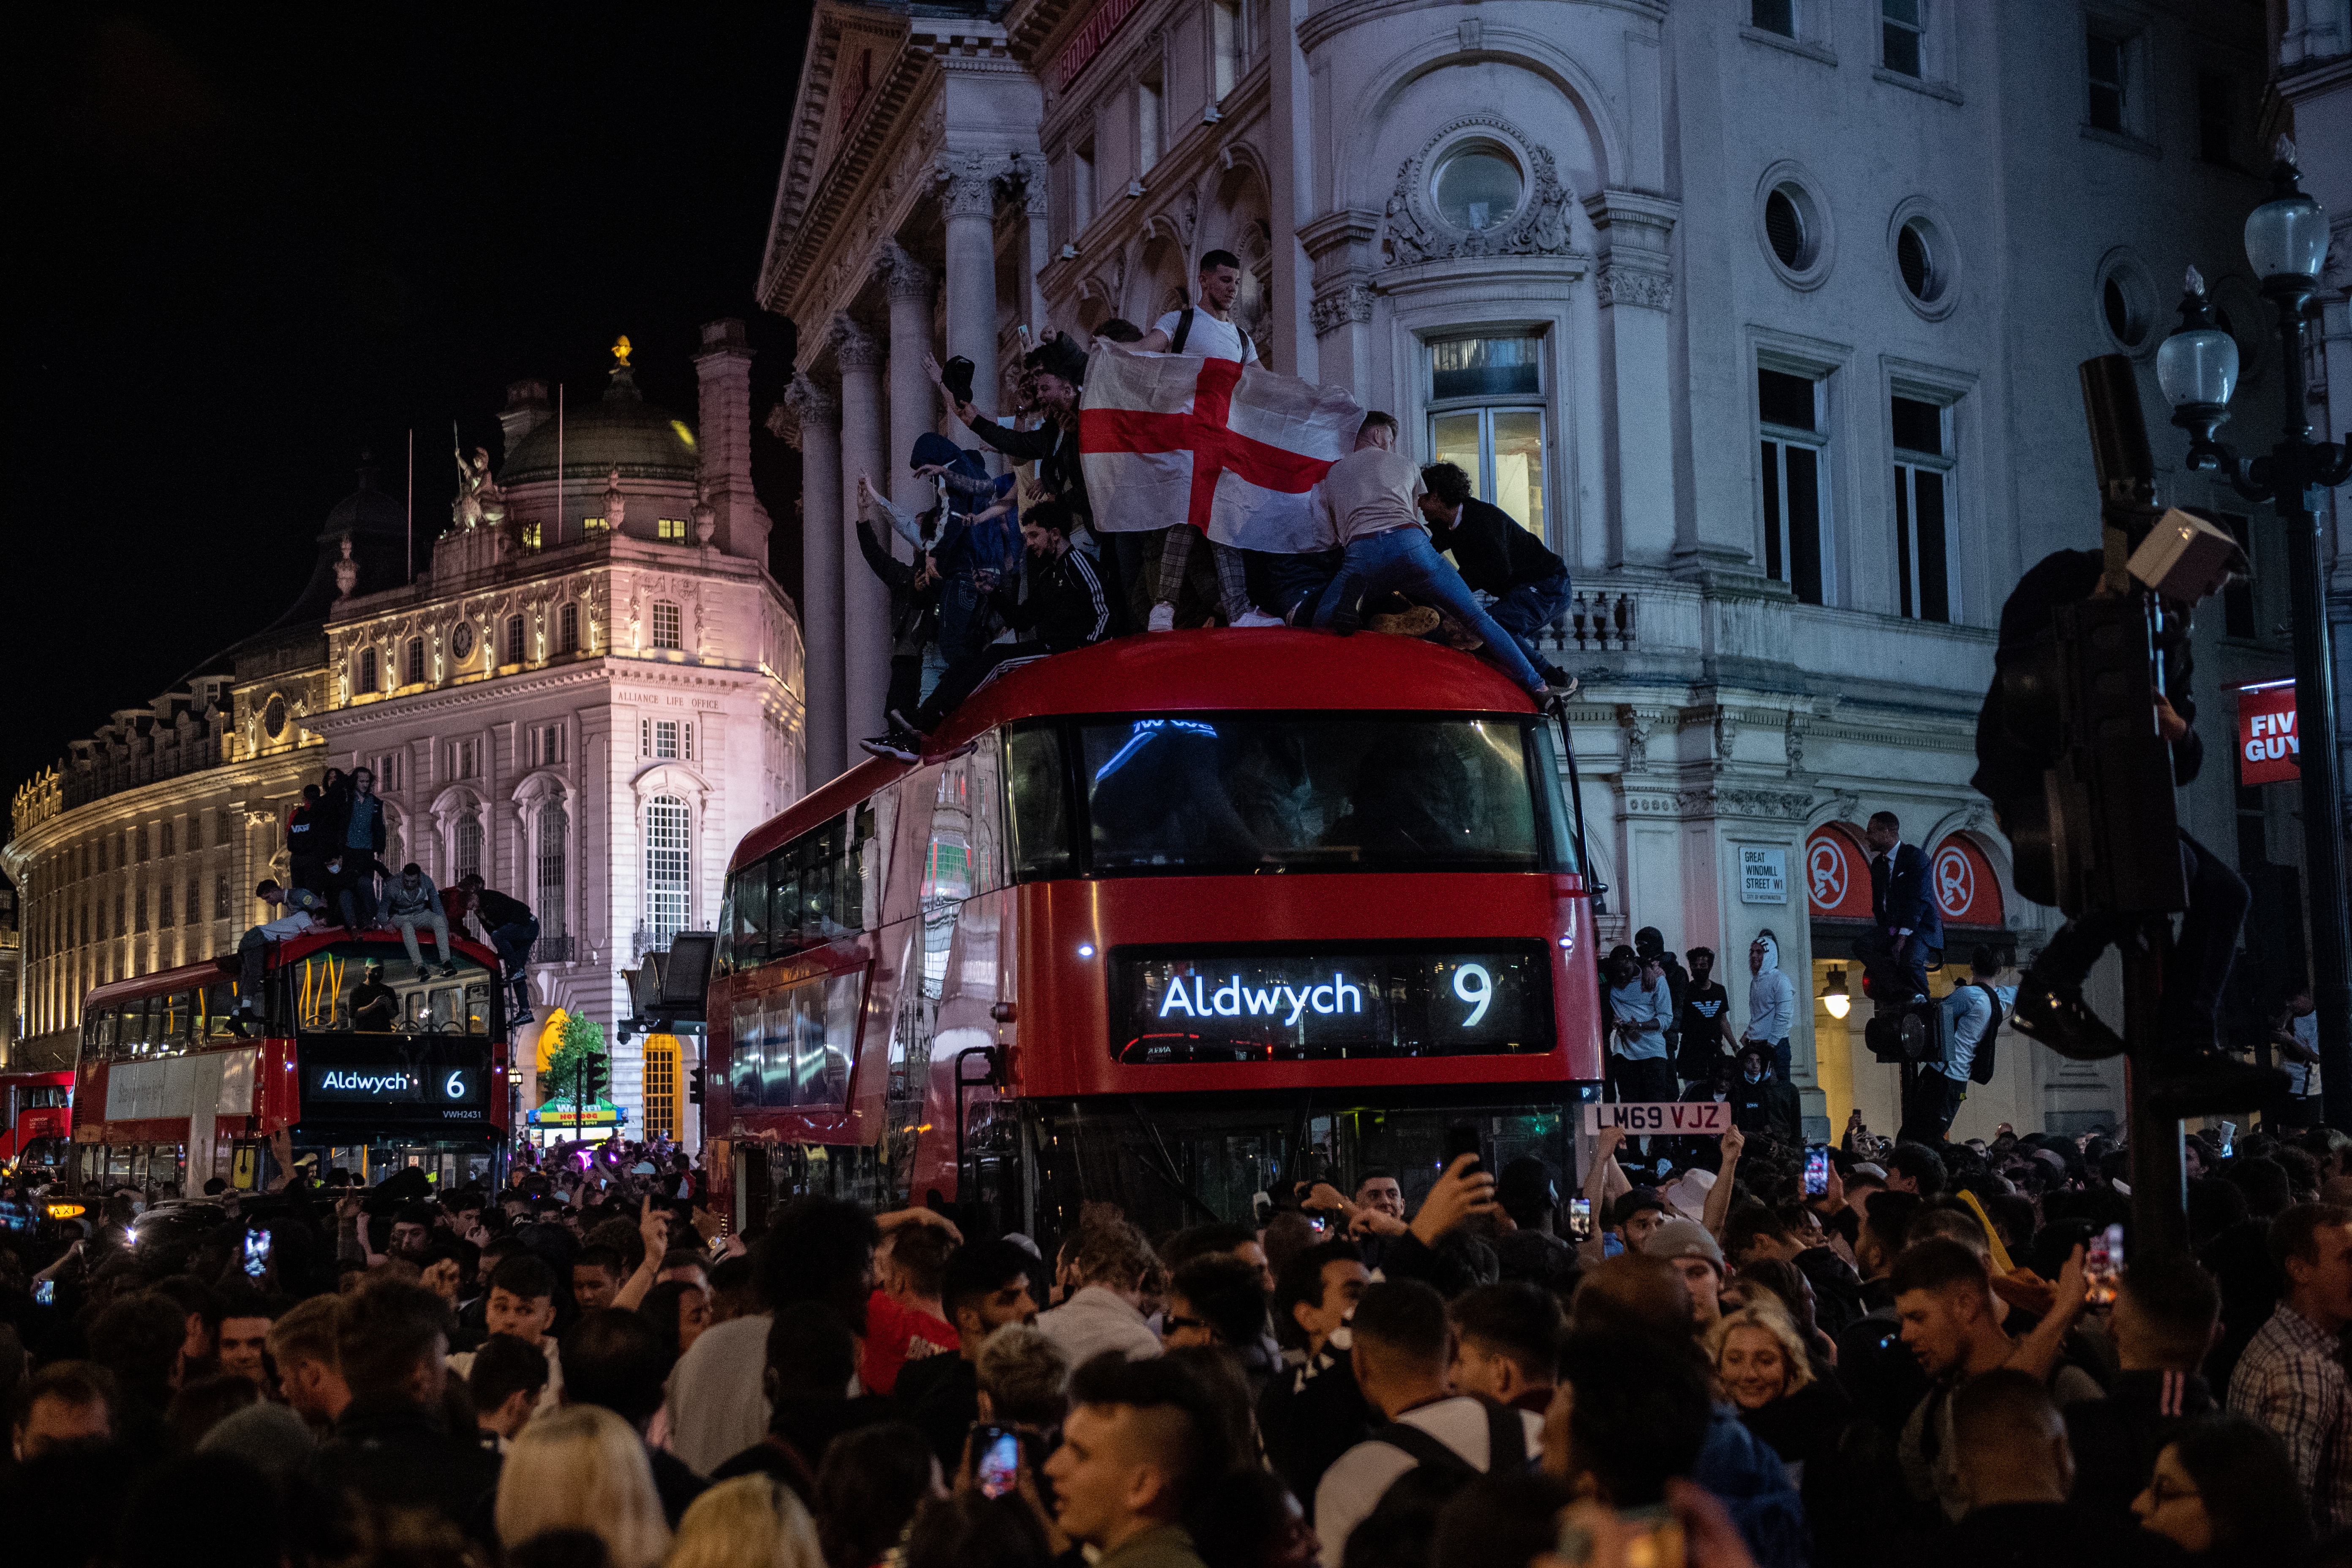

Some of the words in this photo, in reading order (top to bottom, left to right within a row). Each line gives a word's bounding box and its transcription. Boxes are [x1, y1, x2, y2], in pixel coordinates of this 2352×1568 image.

[1059, 16, 1095, 86] BODY
[618, 692, 658, 704] ALLIANCE
[667, 696, 683, 706] LIFE
[691, 698, 719, 709] OFFICE
[2251, 710, 2296, 738] FIV
[2245, 735, 2300, 761] GUY
[1745, 852, 1765, 862] GREAT
[1746, 865, 1777, 876] WINDMILL
[1746, 878, 1769, 889] STREET
[1774, 879, 1783, 889] W1
[1160, 973, 1361, 1026] Aldwych
[1453, 963, 1492, 1026] 9
[322, 1071, 407, 1094] Aldwych
[446, 1070, 465, 1098] 6
[443, 1111, 481, 1119] VWH2431
[1597, 1106, 1662, 1130] LM69
[1670, 1105, 1719, 1128] VJZ
[52, 1207, 76, 1215] AXI
